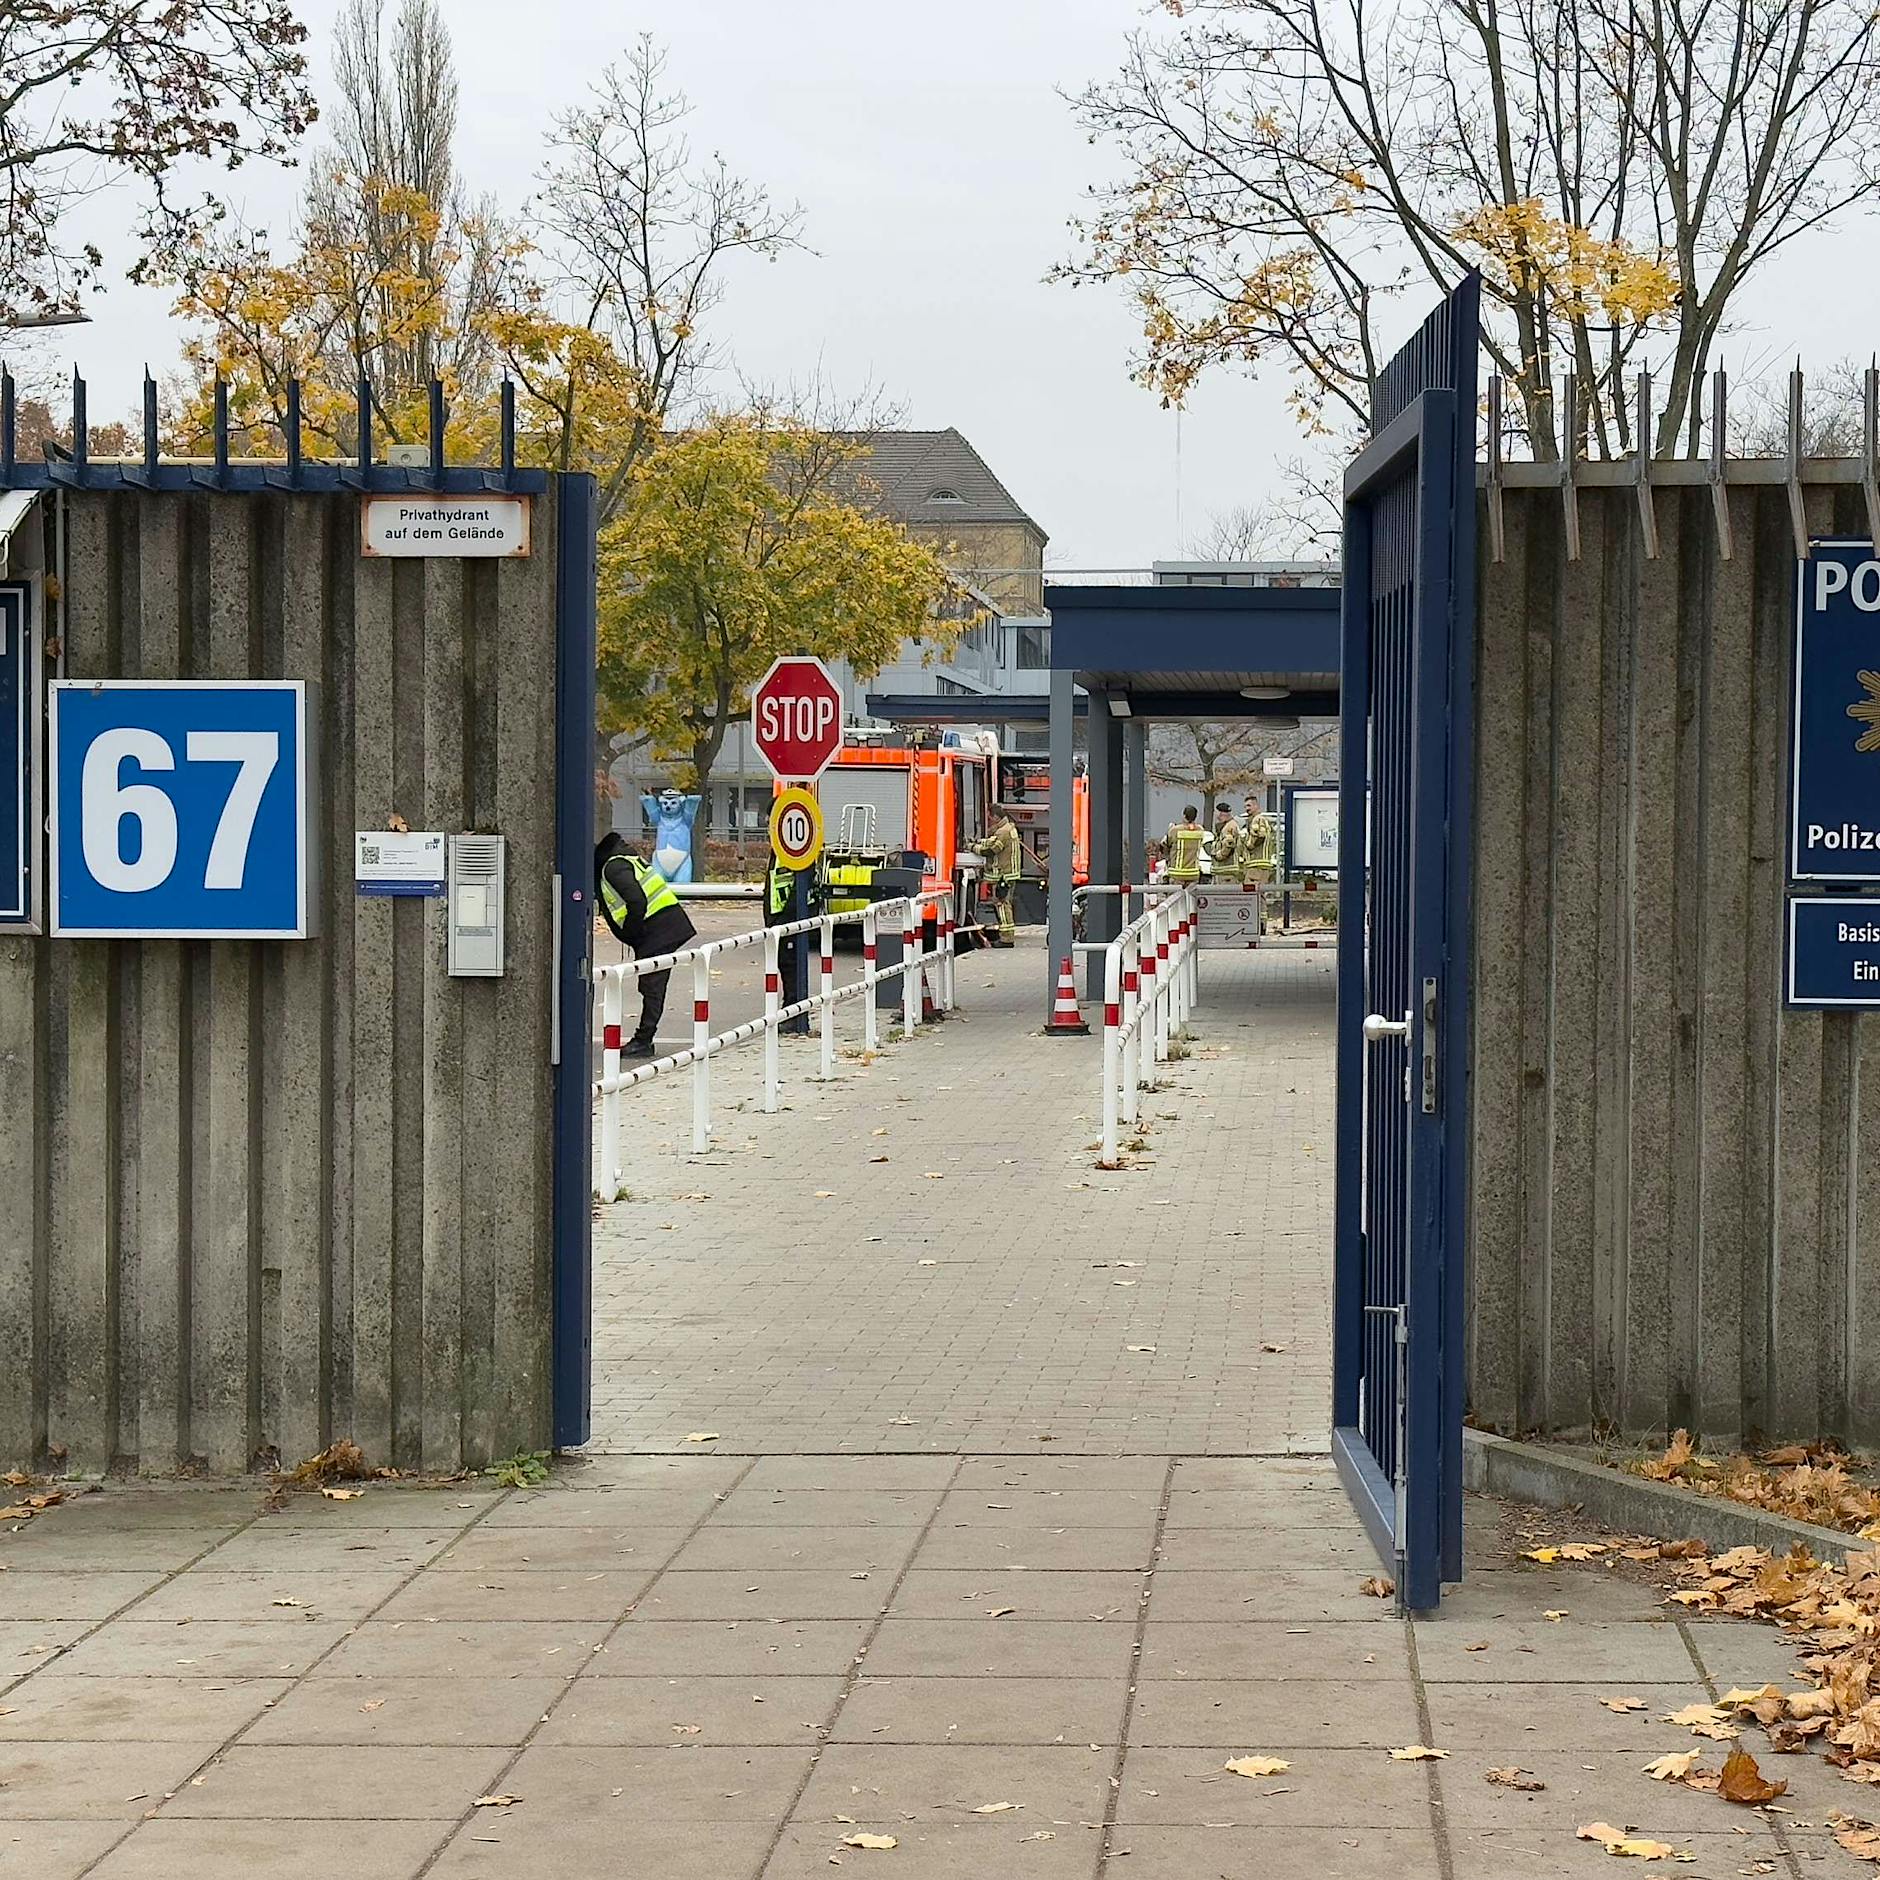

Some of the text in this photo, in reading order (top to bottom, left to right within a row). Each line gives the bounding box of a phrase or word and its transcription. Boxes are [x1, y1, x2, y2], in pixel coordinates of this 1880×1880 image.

[400, 509, 489, 522] Privathydrant
[385, 527, 504, 539] auf dem Gelände
[1815, 560, 1880, 612] PO
[761, 696, 833, 742] STOP
[81, 726, 280, 894] 67
[786, 816, 806, 842] 10
[1838, 922, 1880, 942] Basis
[1853, 960, 1879, 981] Ein
